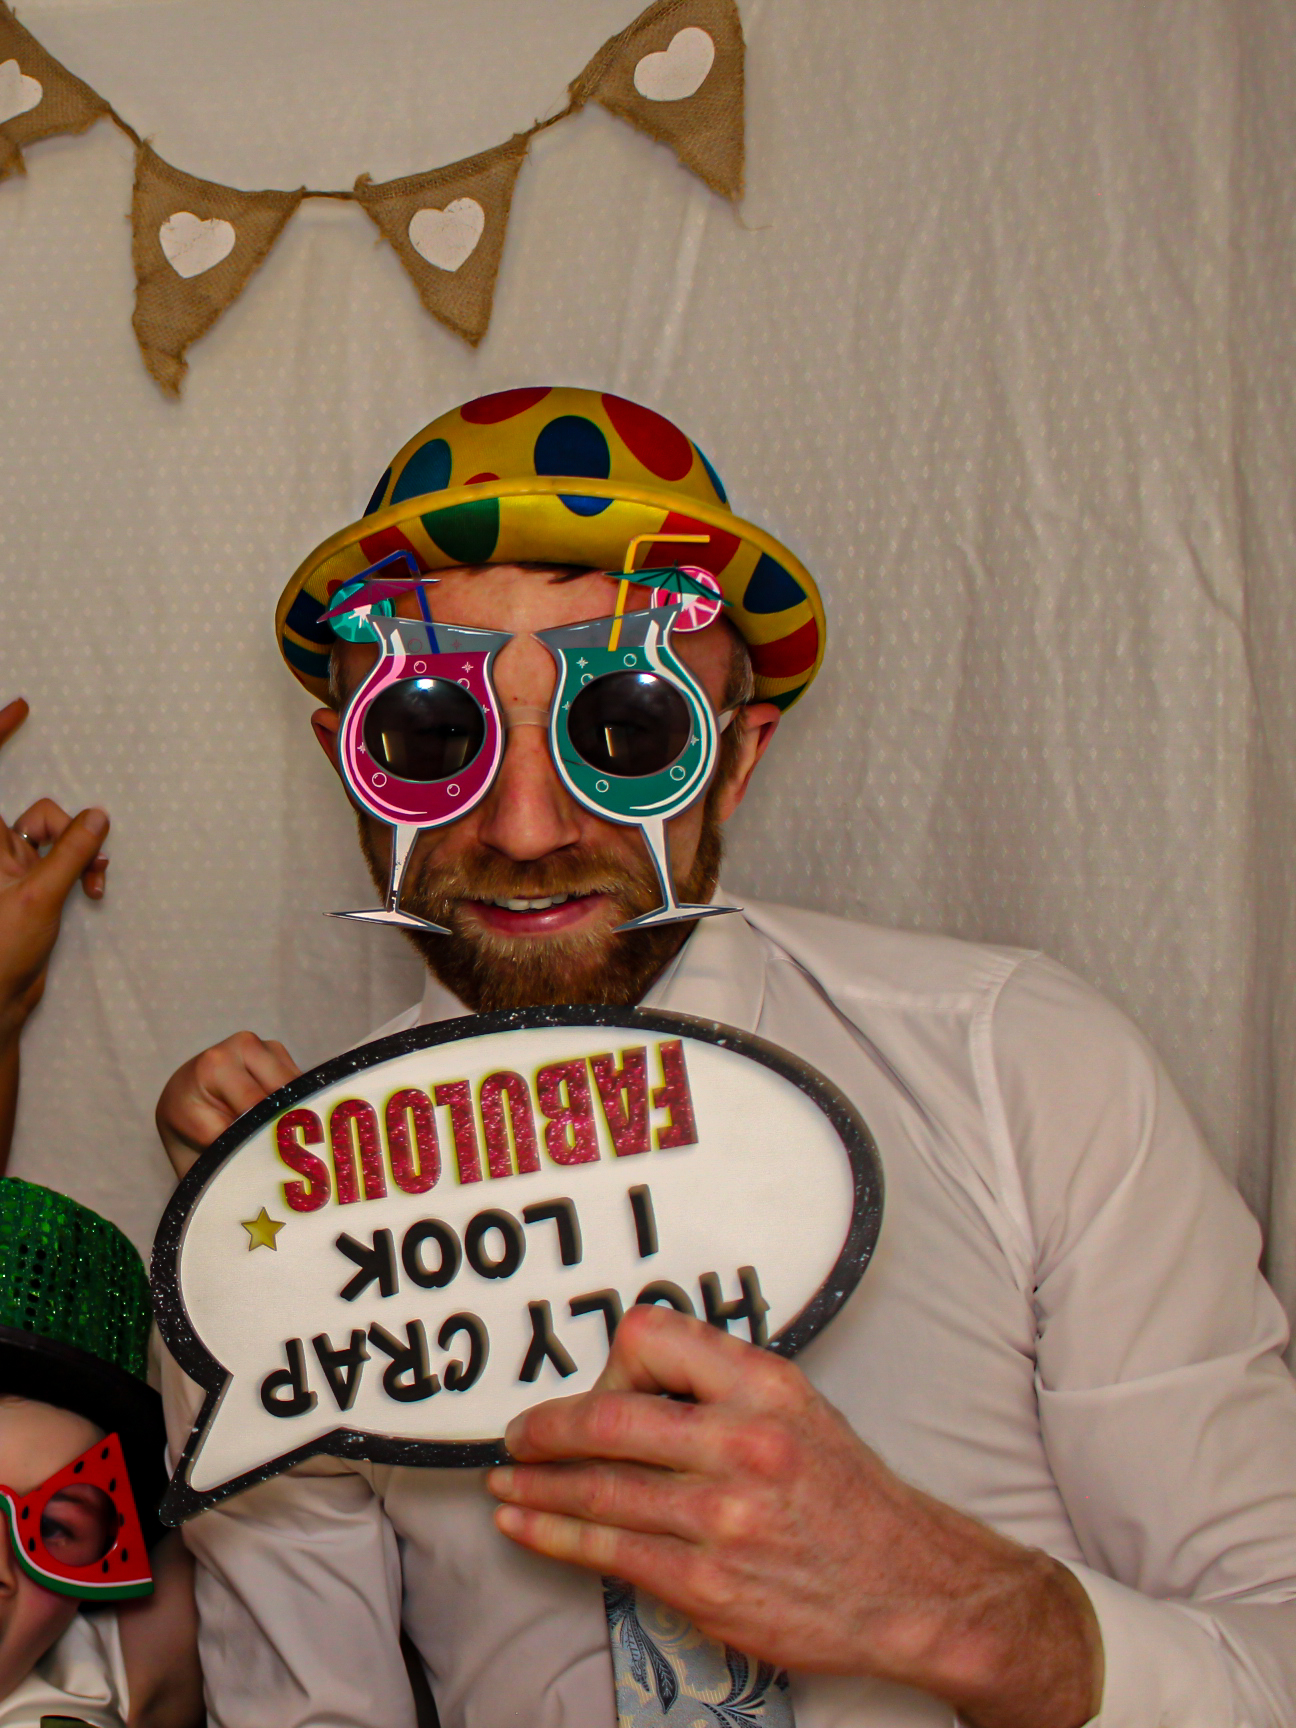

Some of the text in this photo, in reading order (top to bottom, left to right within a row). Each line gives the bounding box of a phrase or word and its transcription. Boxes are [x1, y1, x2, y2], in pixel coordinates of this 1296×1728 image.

[275, 1039, 699, 1213] FABULOUS
[335, 1184, 659, 1302] I LOOK
[260, 1311, 489, 1418] CRAP
